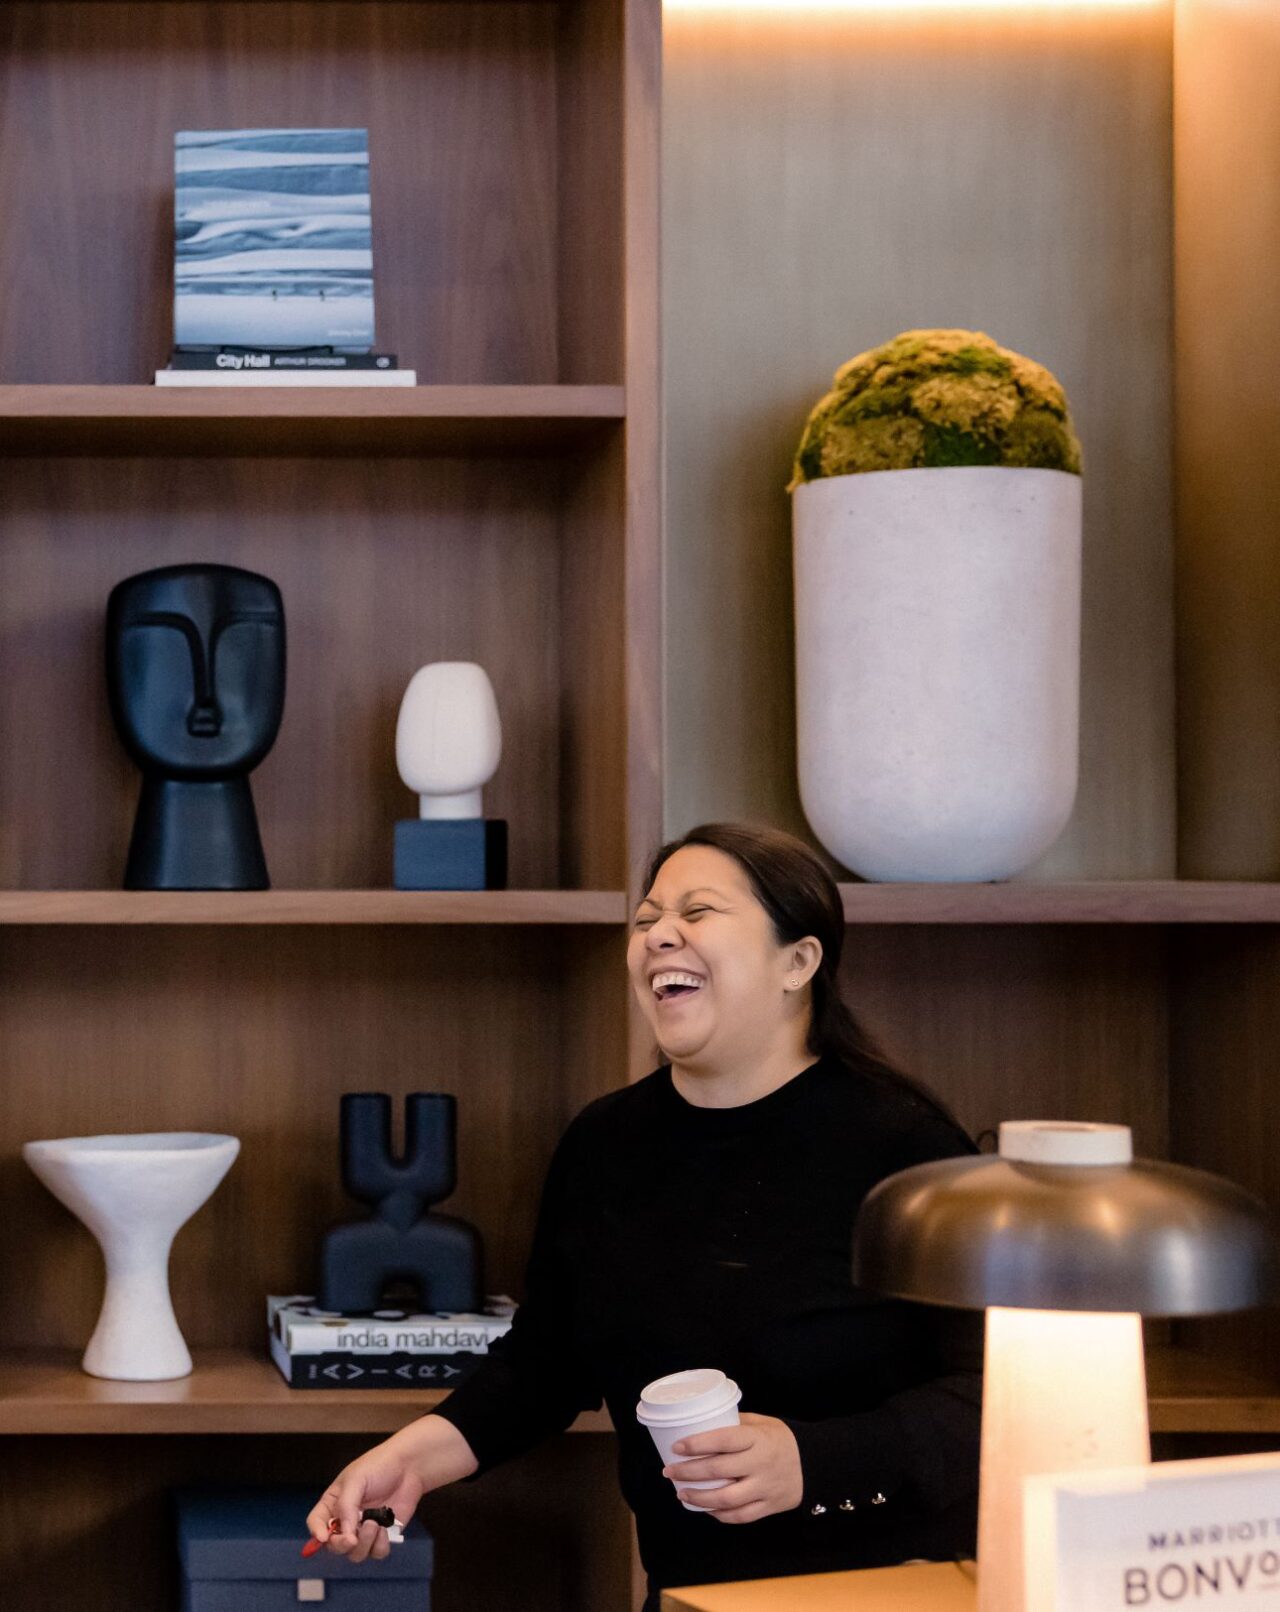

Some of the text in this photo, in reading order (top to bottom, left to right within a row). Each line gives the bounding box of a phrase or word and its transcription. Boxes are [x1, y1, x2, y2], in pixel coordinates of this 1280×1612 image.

[216, 354, 243, 369] City
[244, 354, 270, 368] Hall
[337, 1327, 489, 1348] india mahdavi
